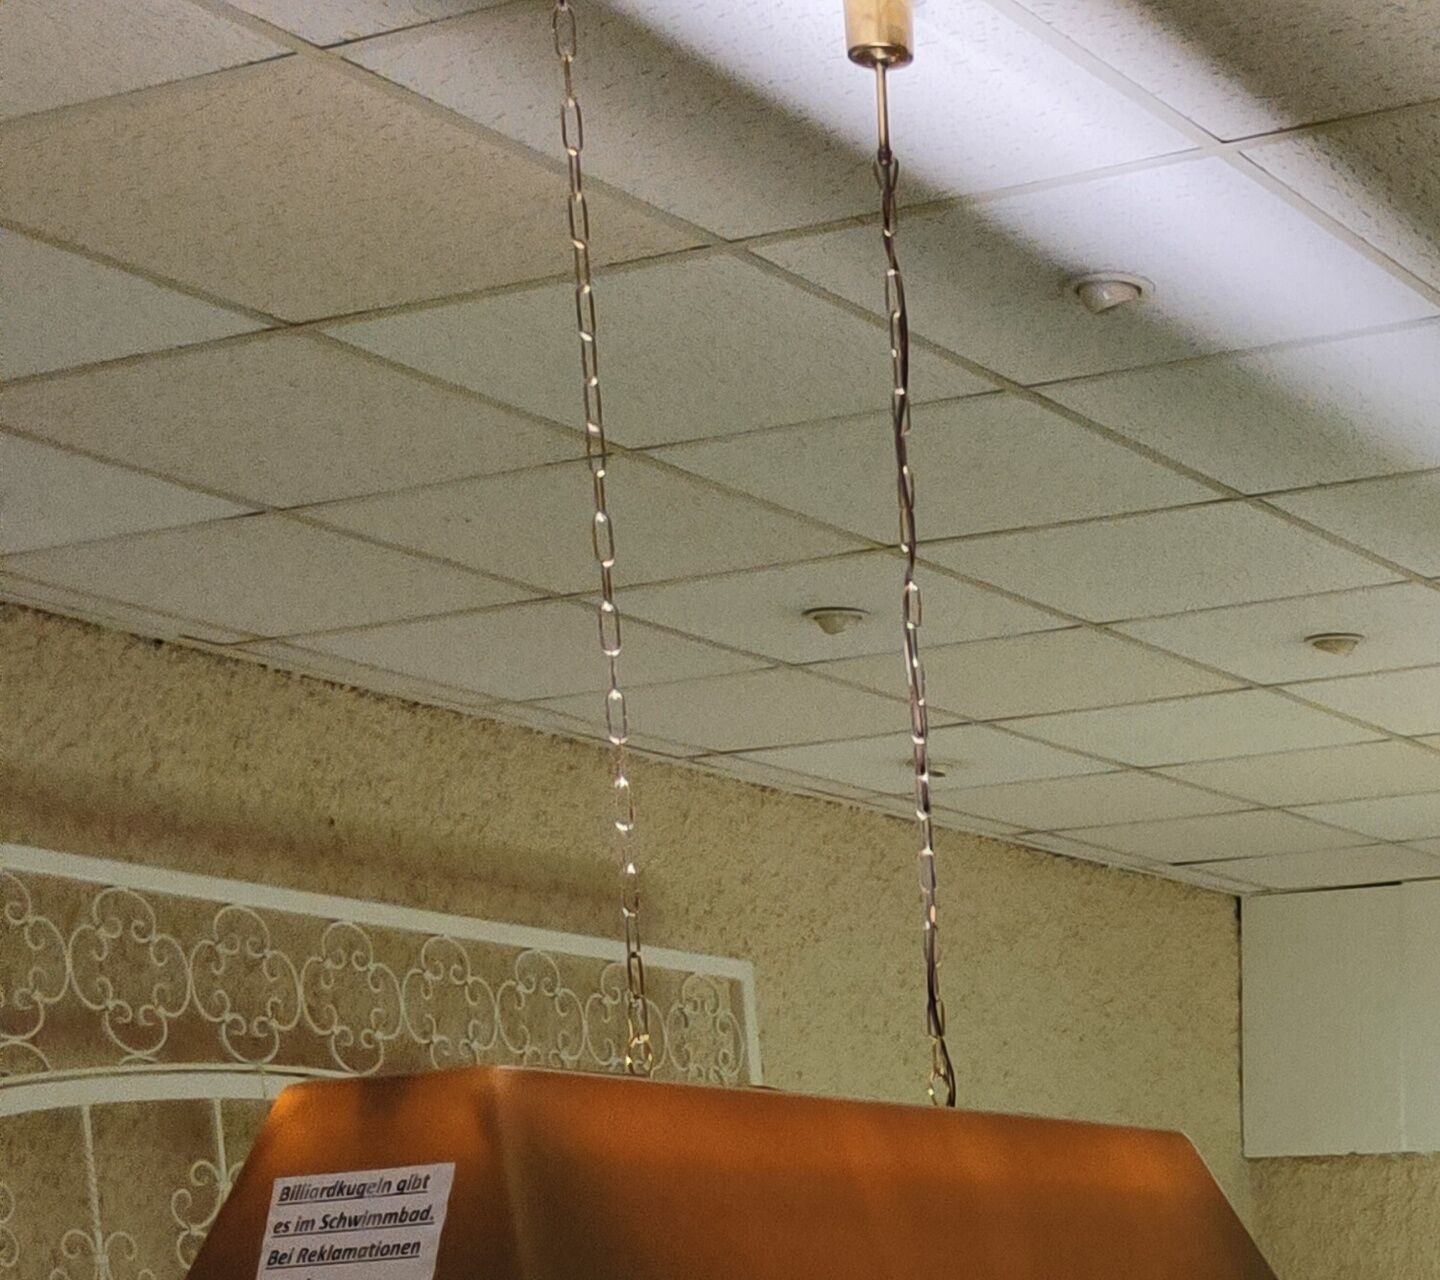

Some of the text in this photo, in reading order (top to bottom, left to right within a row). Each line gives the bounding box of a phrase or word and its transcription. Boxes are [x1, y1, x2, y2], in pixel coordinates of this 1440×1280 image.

[396, 1174, 430, 1194] gibt
[273, 1205, 434, 1233] es im Schwimmbad.
[267, 1240, 421, 1266] Bei Reklamationen
